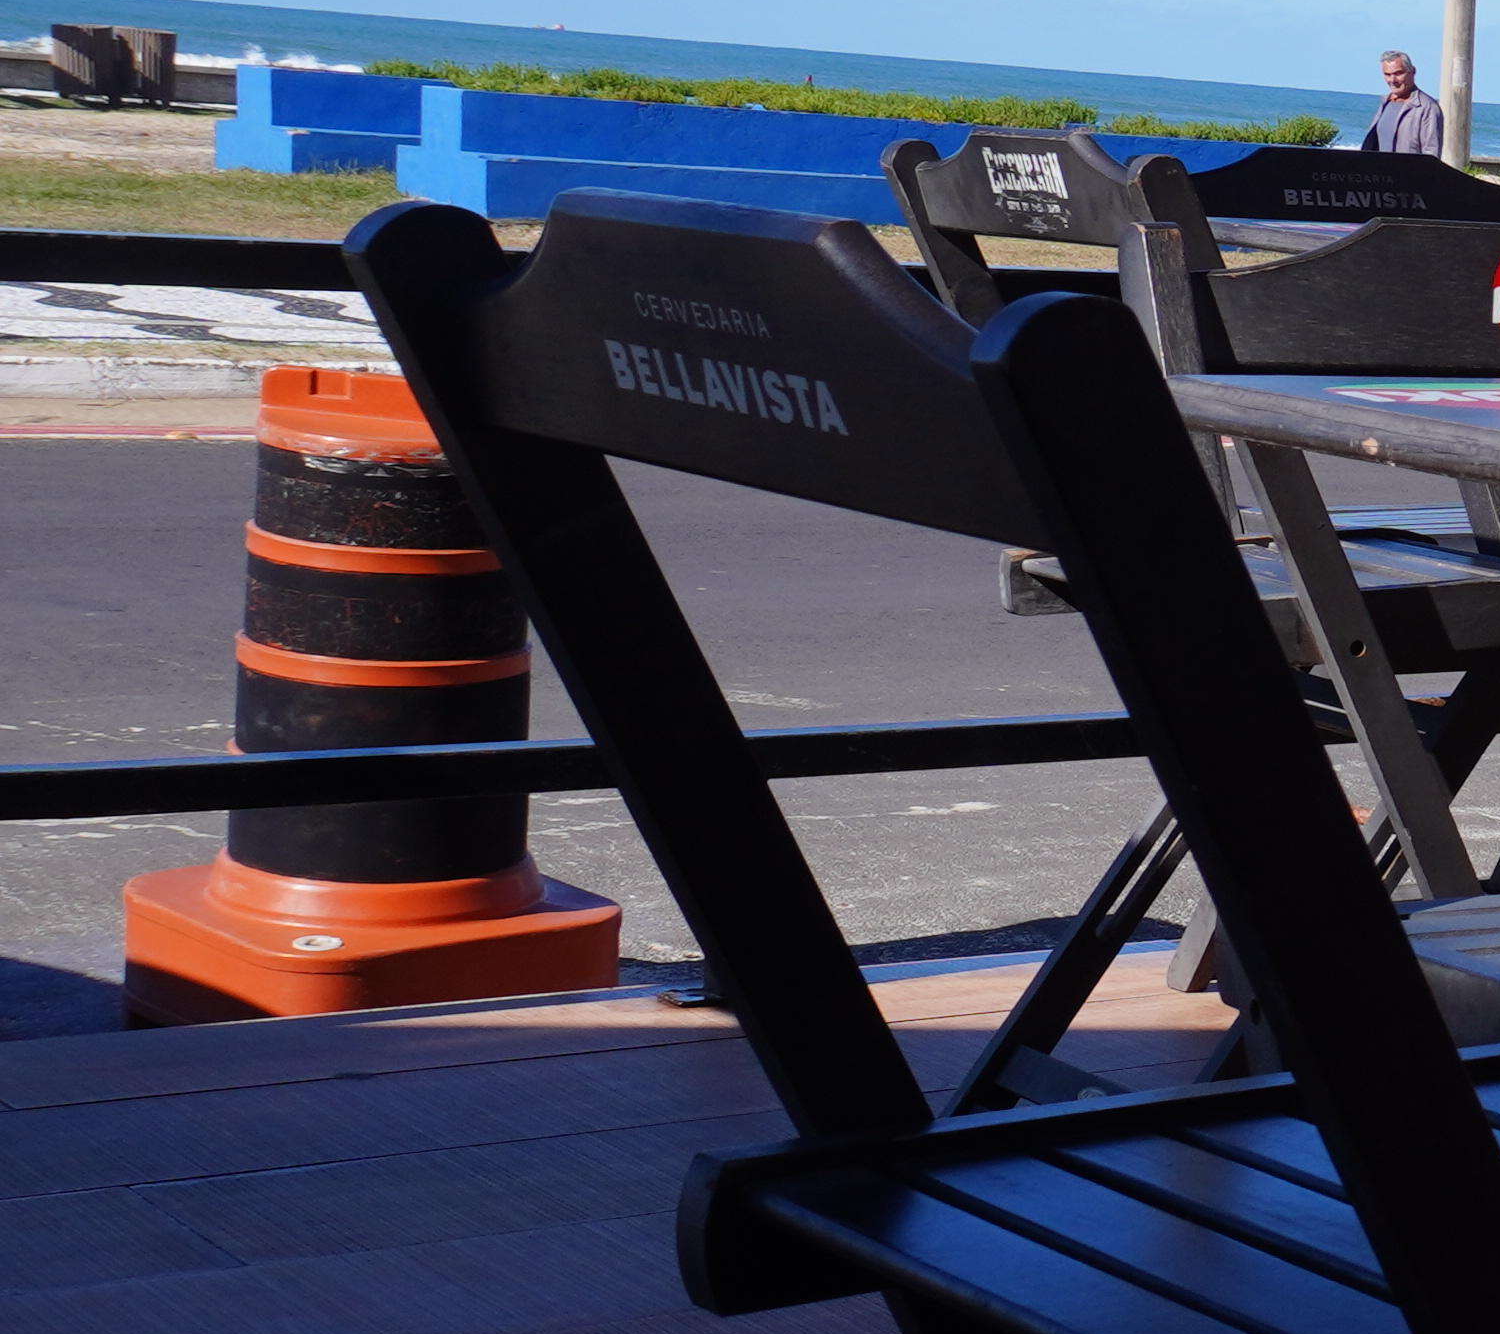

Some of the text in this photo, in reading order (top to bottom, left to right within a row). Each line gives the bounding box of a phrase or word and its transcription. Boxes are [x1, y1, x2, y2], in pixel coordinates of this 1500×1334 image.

[1311, 171, 1394, 185] CERVEJARIA
[1283, 188, 1428, 210] BELLAVISTA
[634, 291, 772, 339] CERVEJARIA
[604, 338, 849, 437] BELLAVISTA
